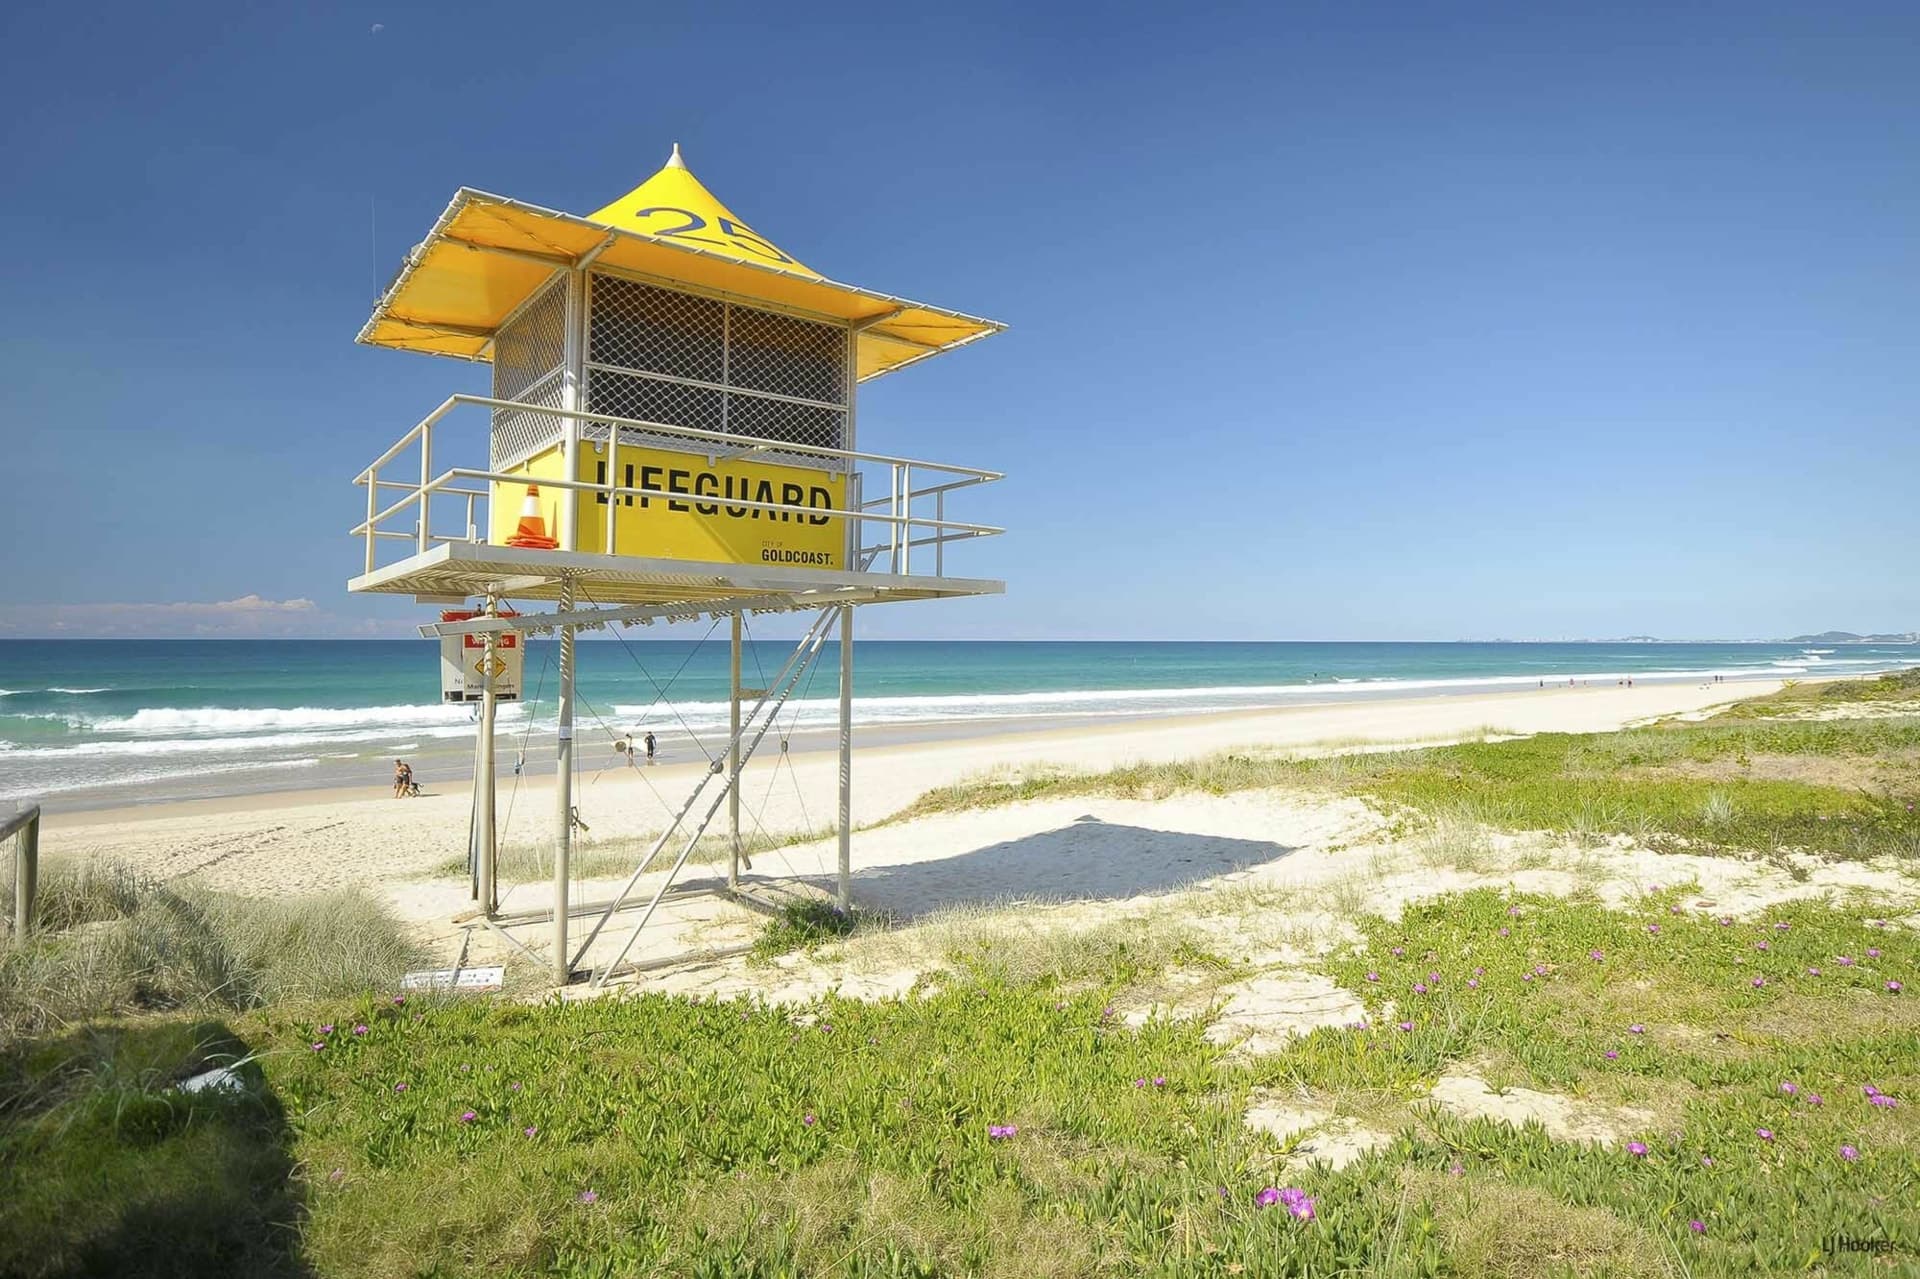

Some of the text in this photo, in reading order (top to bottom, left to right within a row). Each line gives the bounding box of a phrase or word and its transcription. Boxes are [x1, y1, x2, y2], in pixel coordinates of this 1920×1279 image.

[635, 207, 793, 265] 25
[596, 460, 832, 526] LIFEGUARD
[762, 549, 834, 565] GOLDCOAST.
